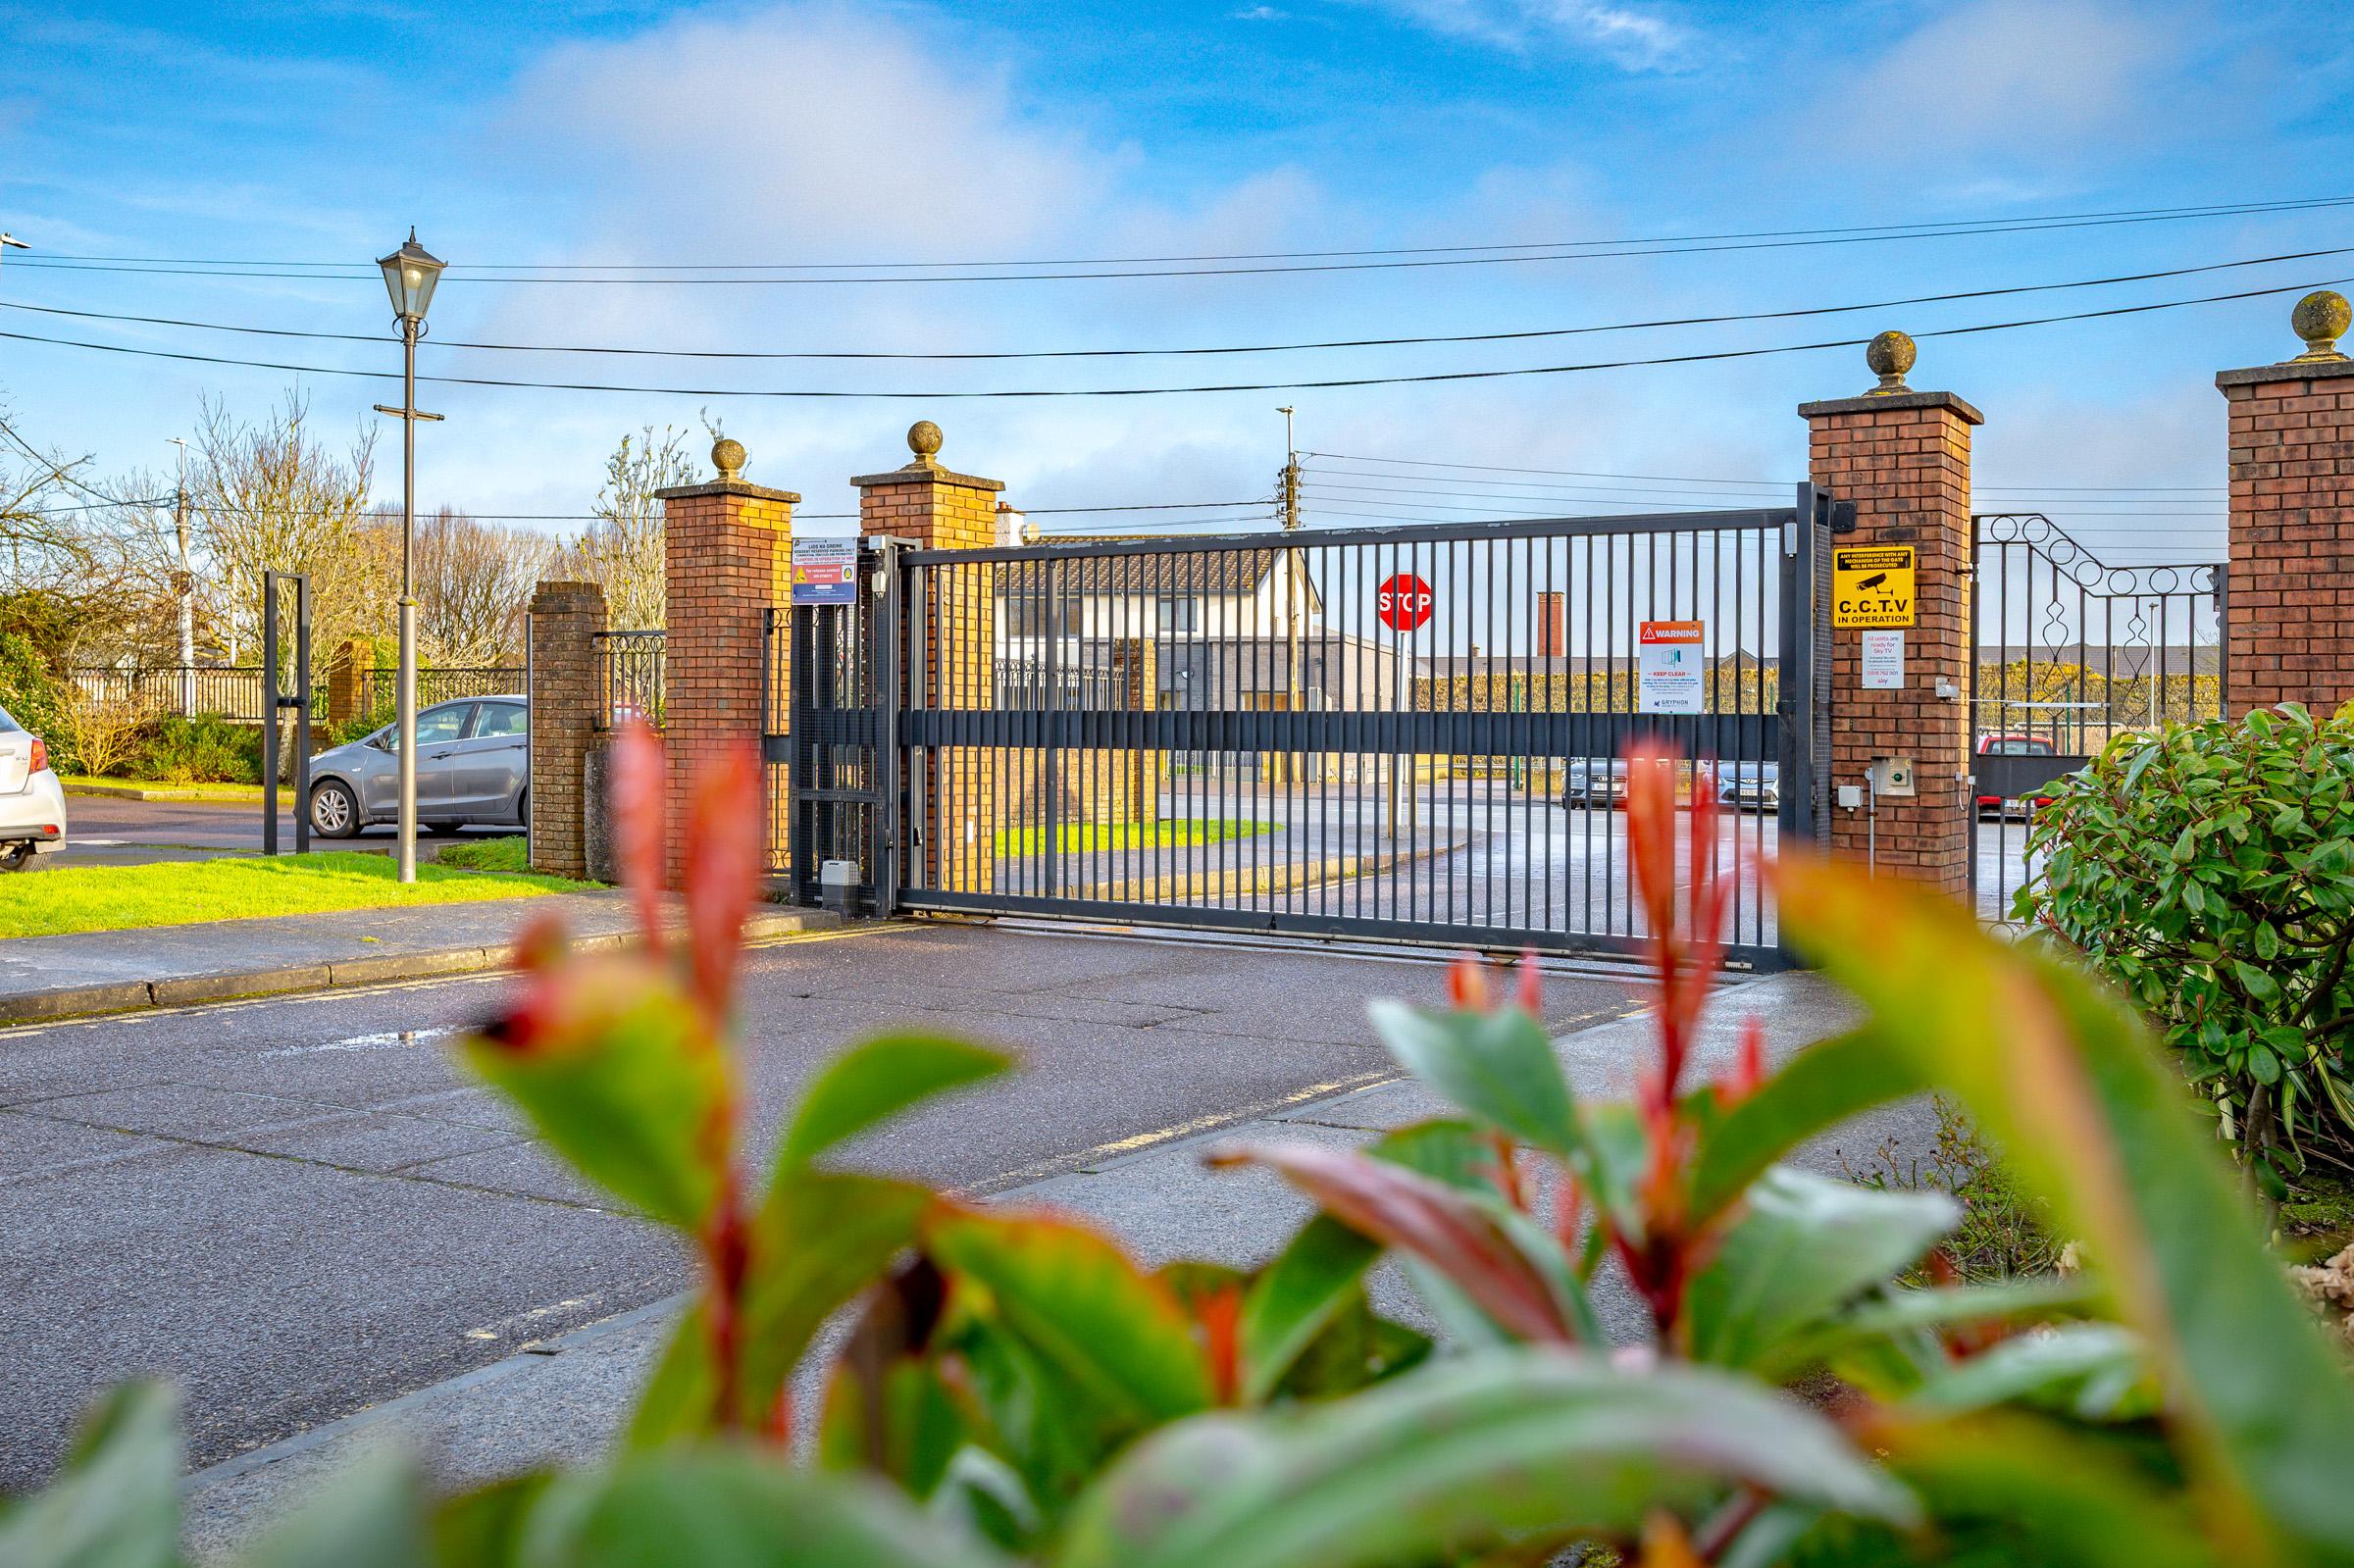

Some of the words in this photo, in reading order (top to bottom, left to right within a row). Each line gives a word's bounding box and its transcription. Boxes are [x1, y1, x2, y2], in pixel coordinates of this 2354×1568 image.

[1379, 591, 1431, 613] STOP
[1839, 599, 1908, 614] C.C.T.V
[1851, 615, 1910, 624] OPERATION
